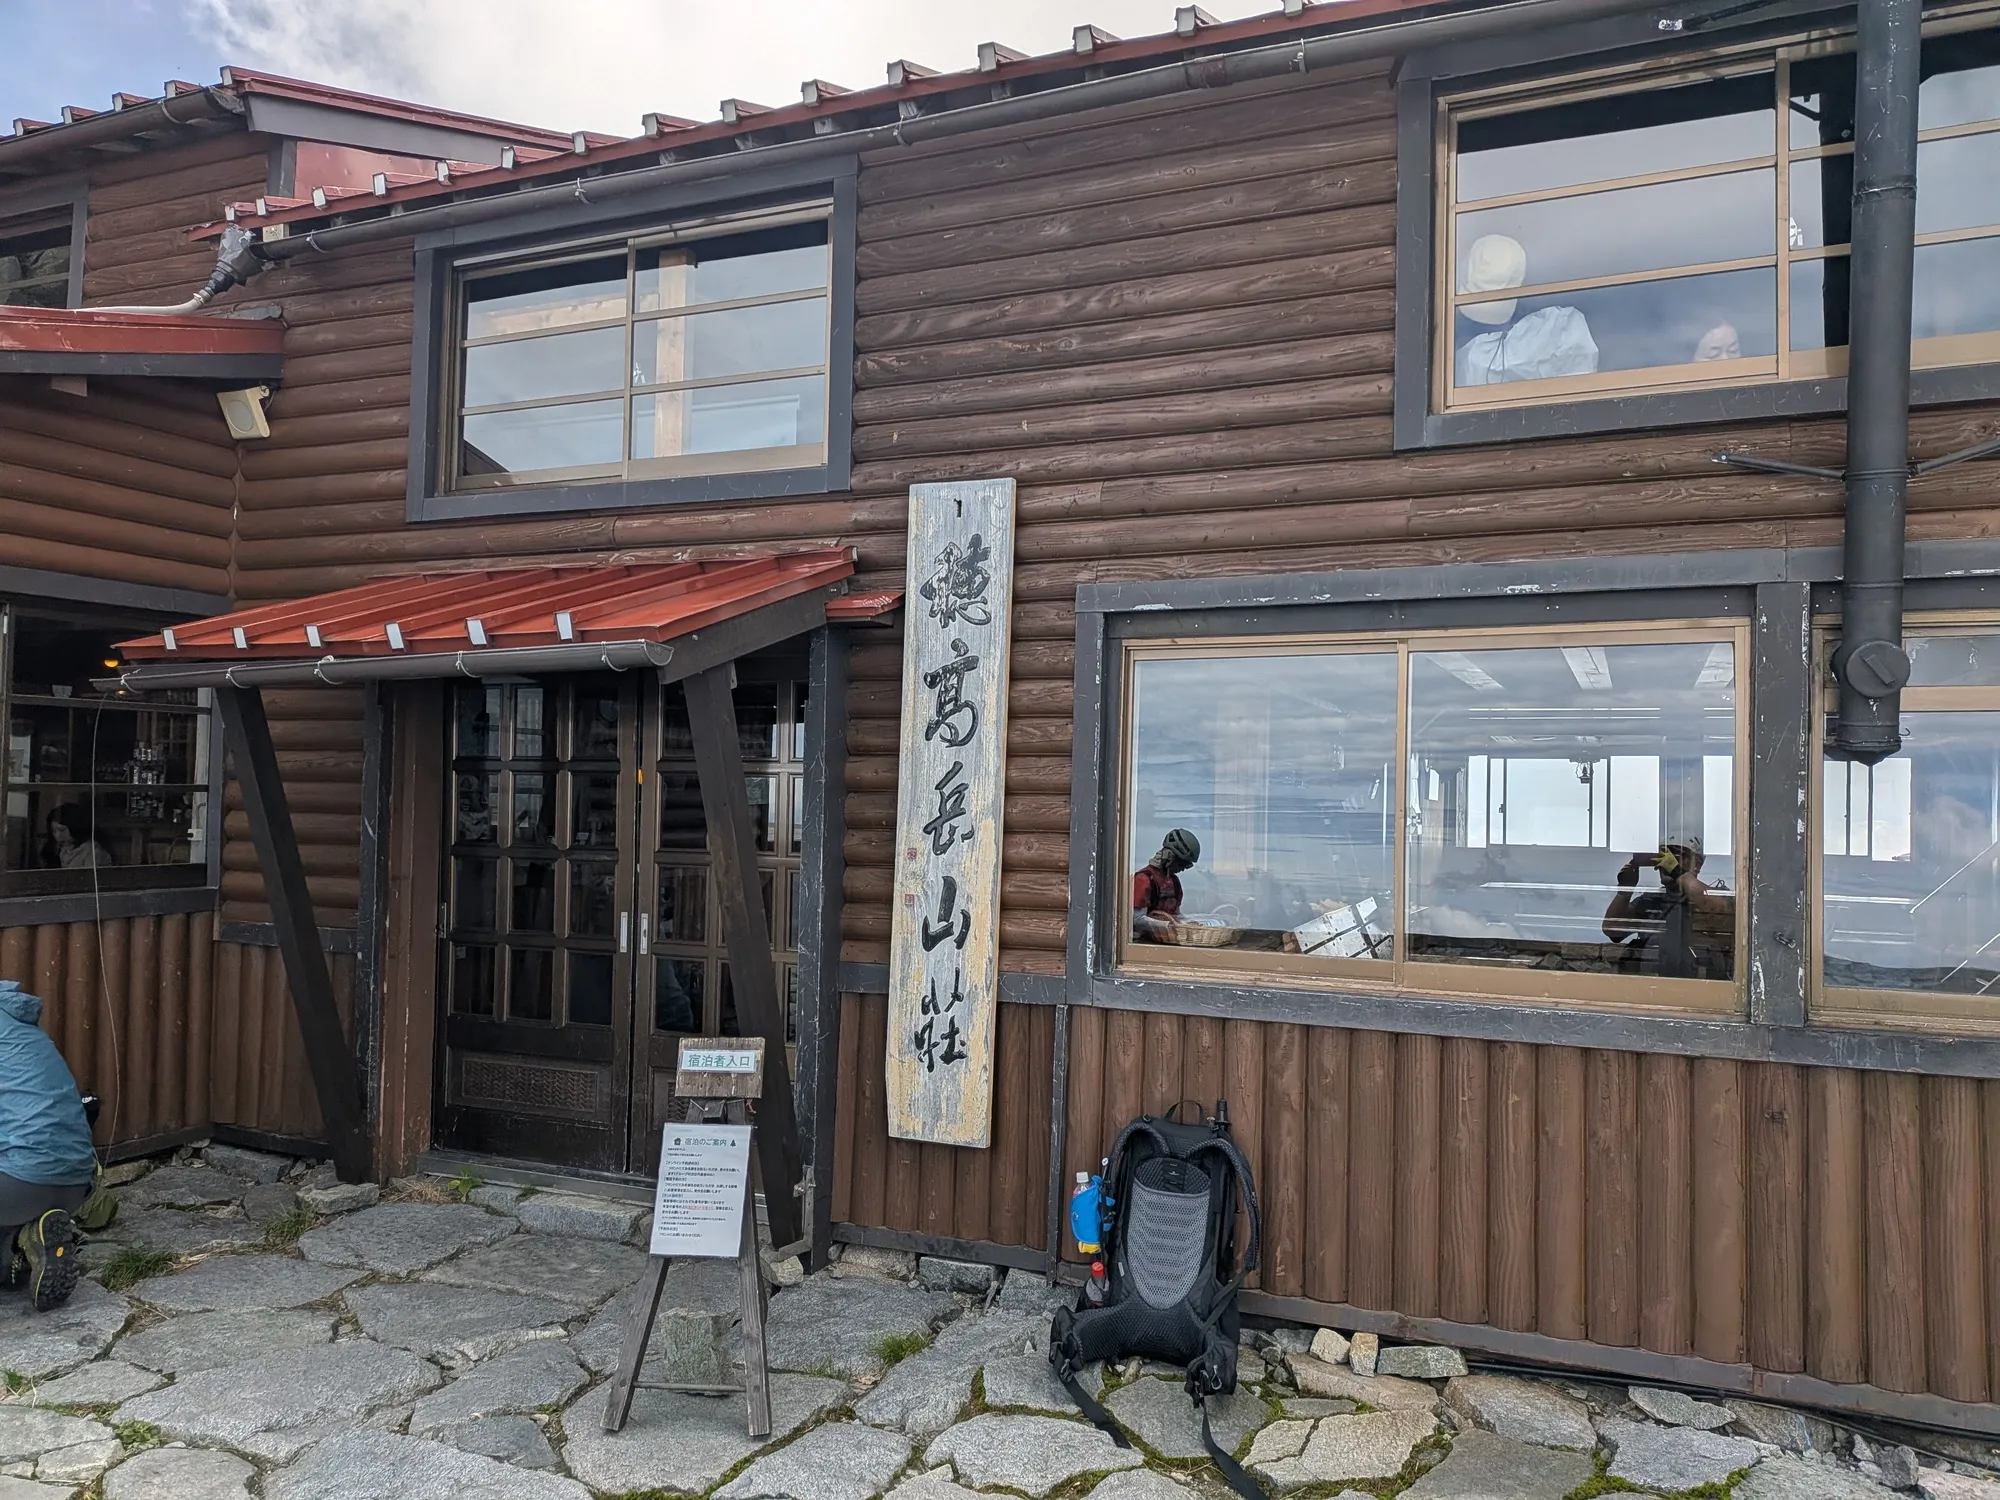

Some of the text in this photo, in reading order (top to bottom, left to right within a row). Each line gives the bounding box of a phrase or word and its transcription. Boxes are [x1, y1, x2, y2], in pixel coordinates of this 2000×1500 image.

[688, 1055, 750, 1068] 宿泊者入口
[684, 1137, 727, 1146] 宿泊のご案内
